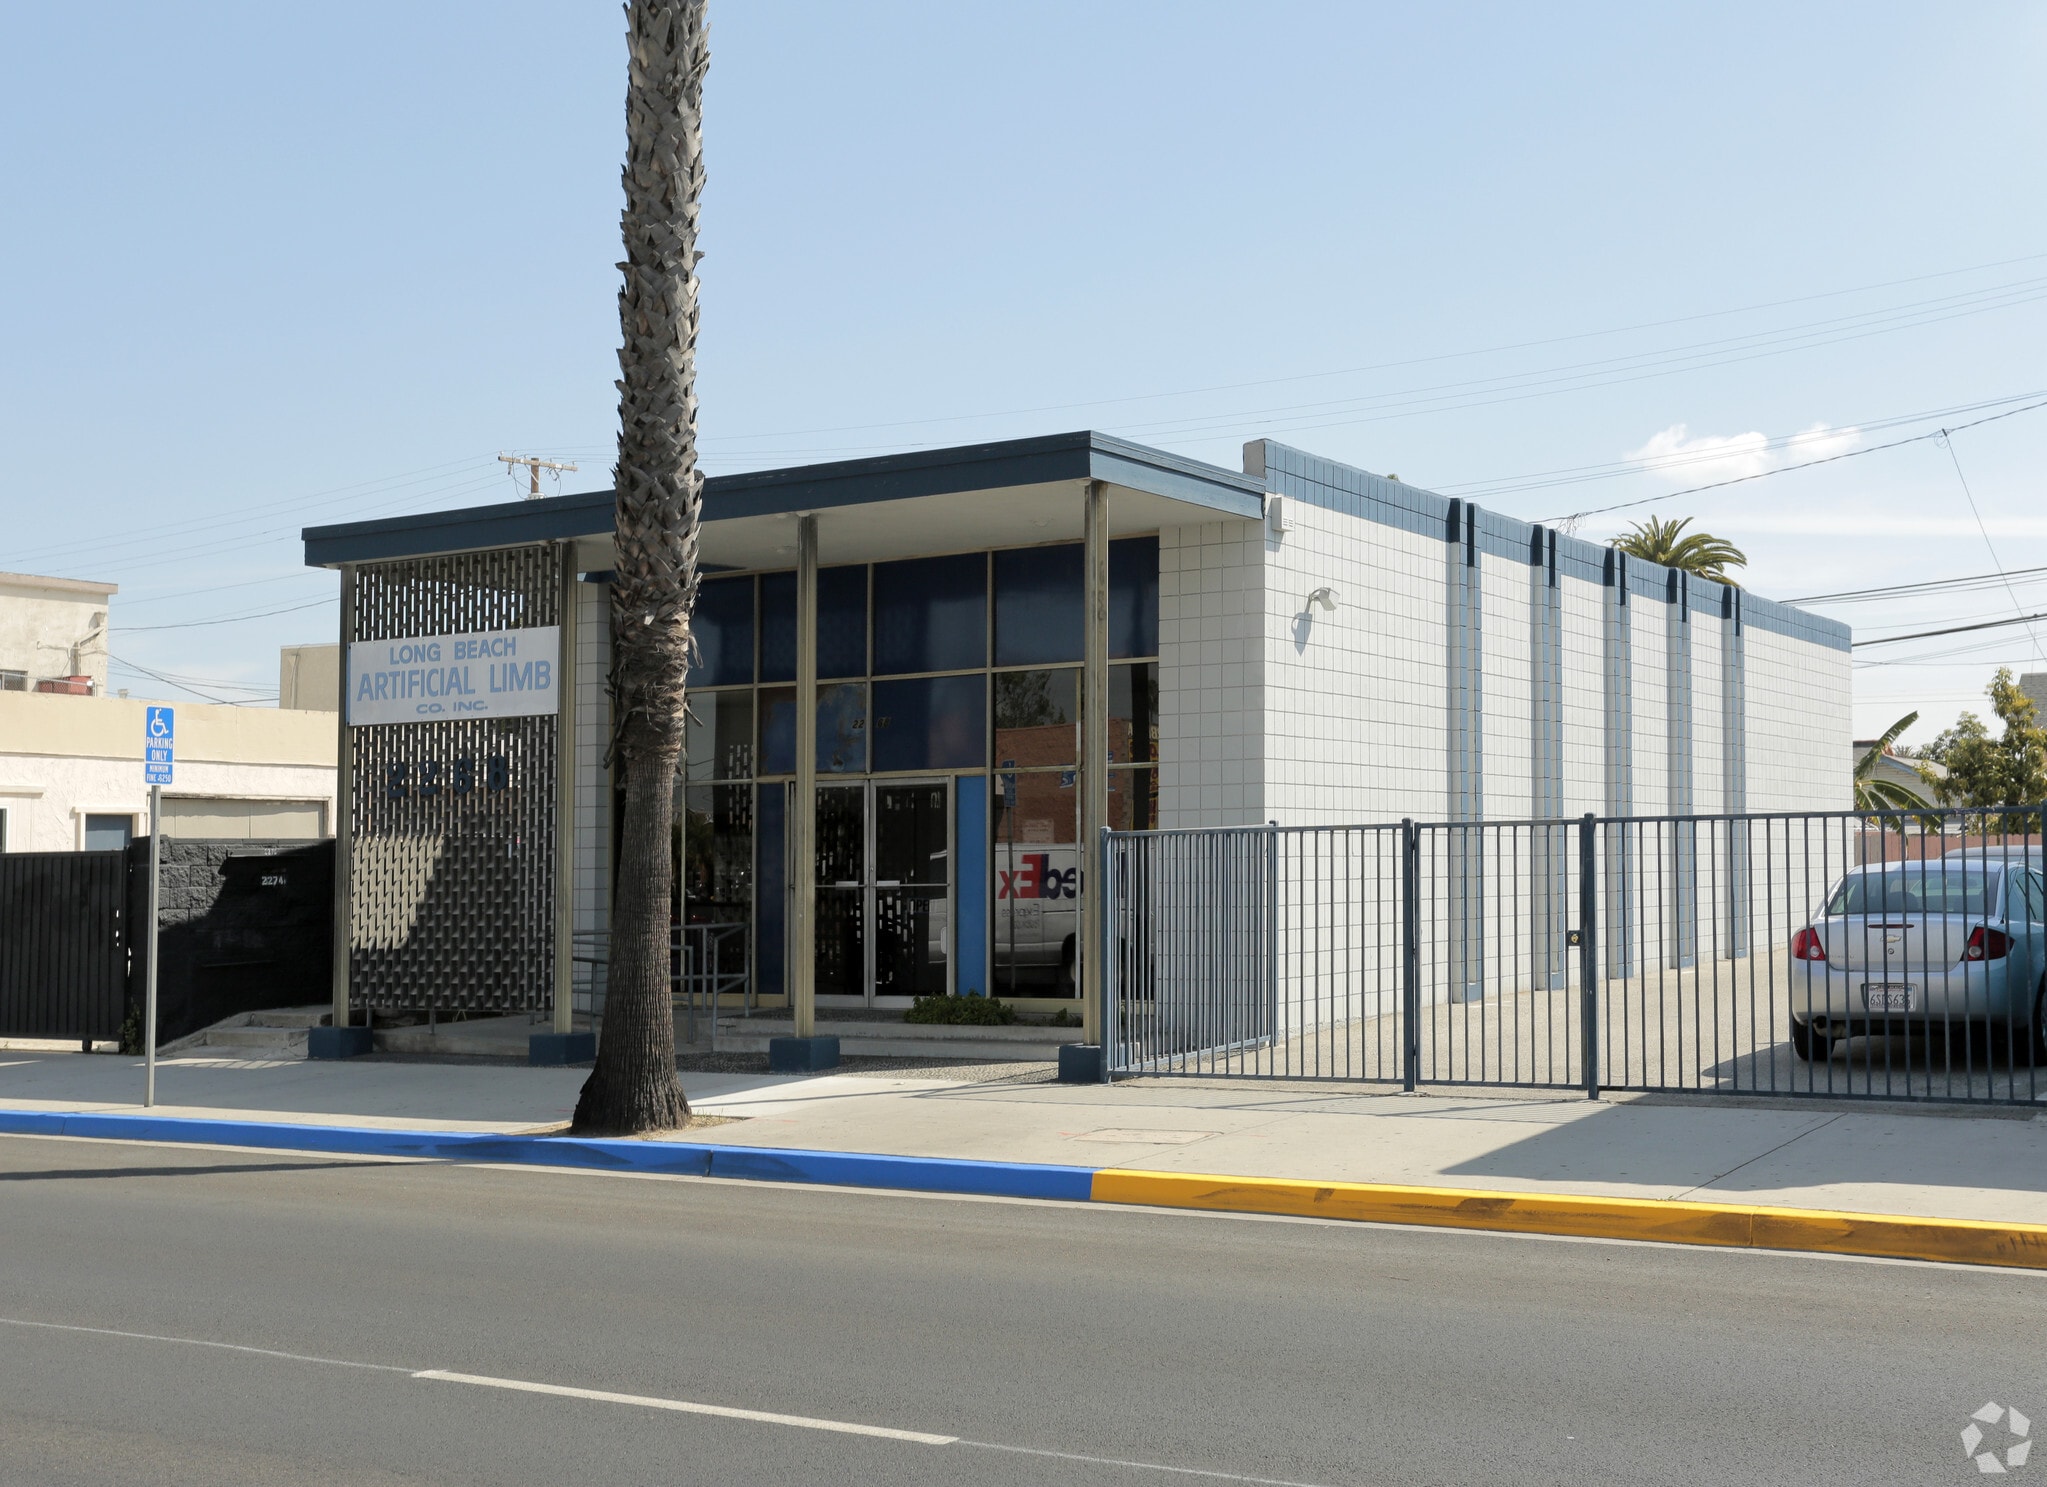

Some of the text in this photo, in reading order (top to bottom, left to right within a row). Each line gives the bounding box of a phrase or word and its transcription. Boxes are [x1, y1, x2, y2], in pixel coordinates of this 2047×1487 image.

[389, 636, 516, 665] LONG BEACH
[356, 660, 551, 702] ARTIFICIAL LIMB
[416, 700, 488, 715] CO. INC.
[146, 736, 173, 750] PARKING
[151, 749, 168, 761] ONLY
[149, 764, 169, 774] MINIMUM
[387, 753, 508, 798] 2268
[146, 773, 157, 783] FINE
[261, 875, 287, 886] 2274
